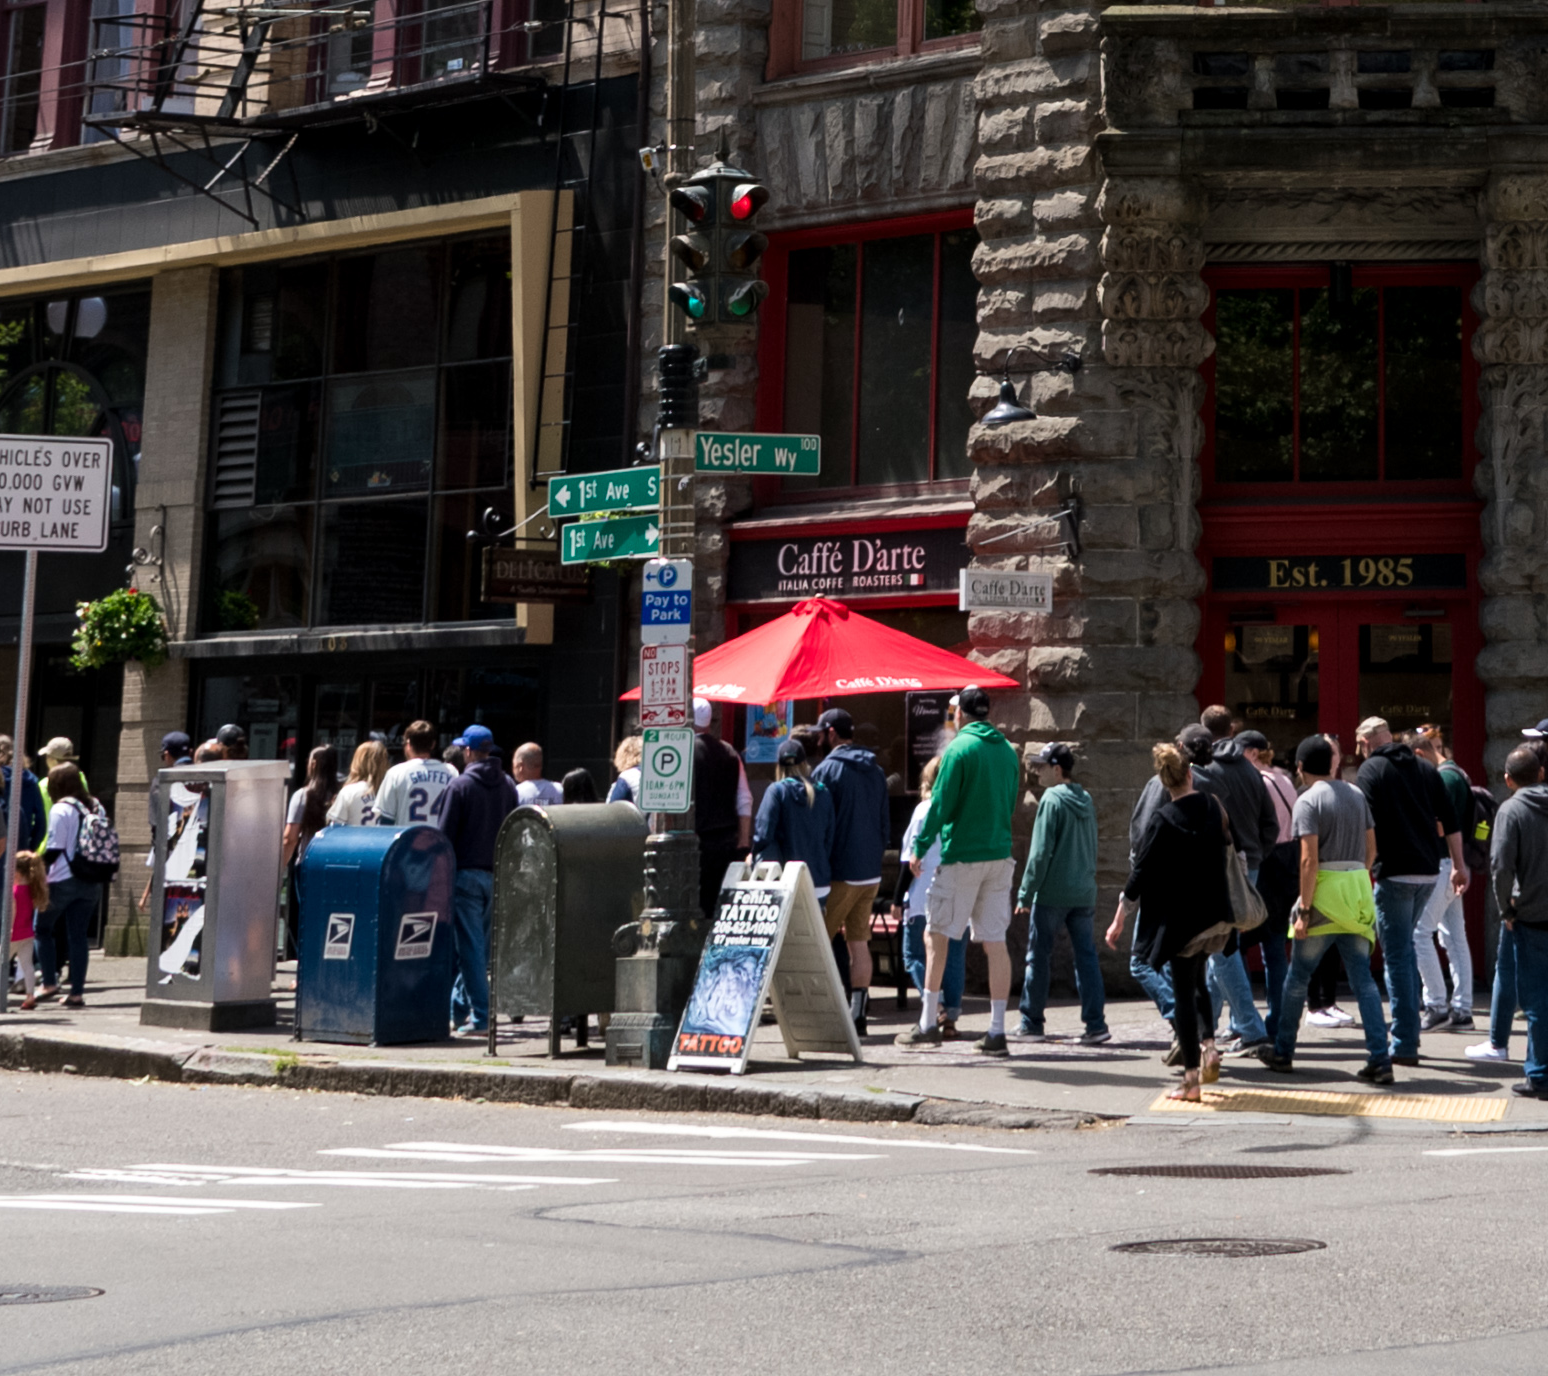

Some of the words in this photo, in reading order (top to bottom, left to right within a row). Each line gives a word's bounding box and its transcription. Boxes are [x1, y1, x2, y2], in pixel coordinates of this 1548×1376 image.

[62, 451, 101, 469] OVER
[700, 436, 762, 466] Yesler
[774, 448, 797, 471] Wy
[53, 474, 85, 491] GVW
[578, 480, 598, 508] 1st
[605, 482, 630, 501] Ave
[647, 476, 657, 497] S
[23, 498, 53, 514] NOT
[62, 499, 91, 515] USE
[40, 522, 79, 539] LANE
[570, 529, 586, 557] 1st
[593, 532, 615, 550] Ave
[777, 541, 844, 576] Caffé
[852, 539, 926, 573] D'arte
[1267, 559, 1328, 588] Est.
[1340, 557, 1414, 587] 1985
[778, 577, 809, 591] ITALIA
[852, 574, 903, 587] ROASTERS
[645, 594, 670, 608] Pay
[674, 593, 688, 606] to
[651, 608, 682, 621] Park
[643, 648, 656, 658] NO
[648, 661, 680, 676] STOPS
[648, 730, 657, 742] 2
[663, 732, 687, 741] HOUR
[410, 769, 453, 786] GRIFFEY
[719, 904, 780, 921] TATTOO
[678, 1033, 743, 1054] TATTOO
